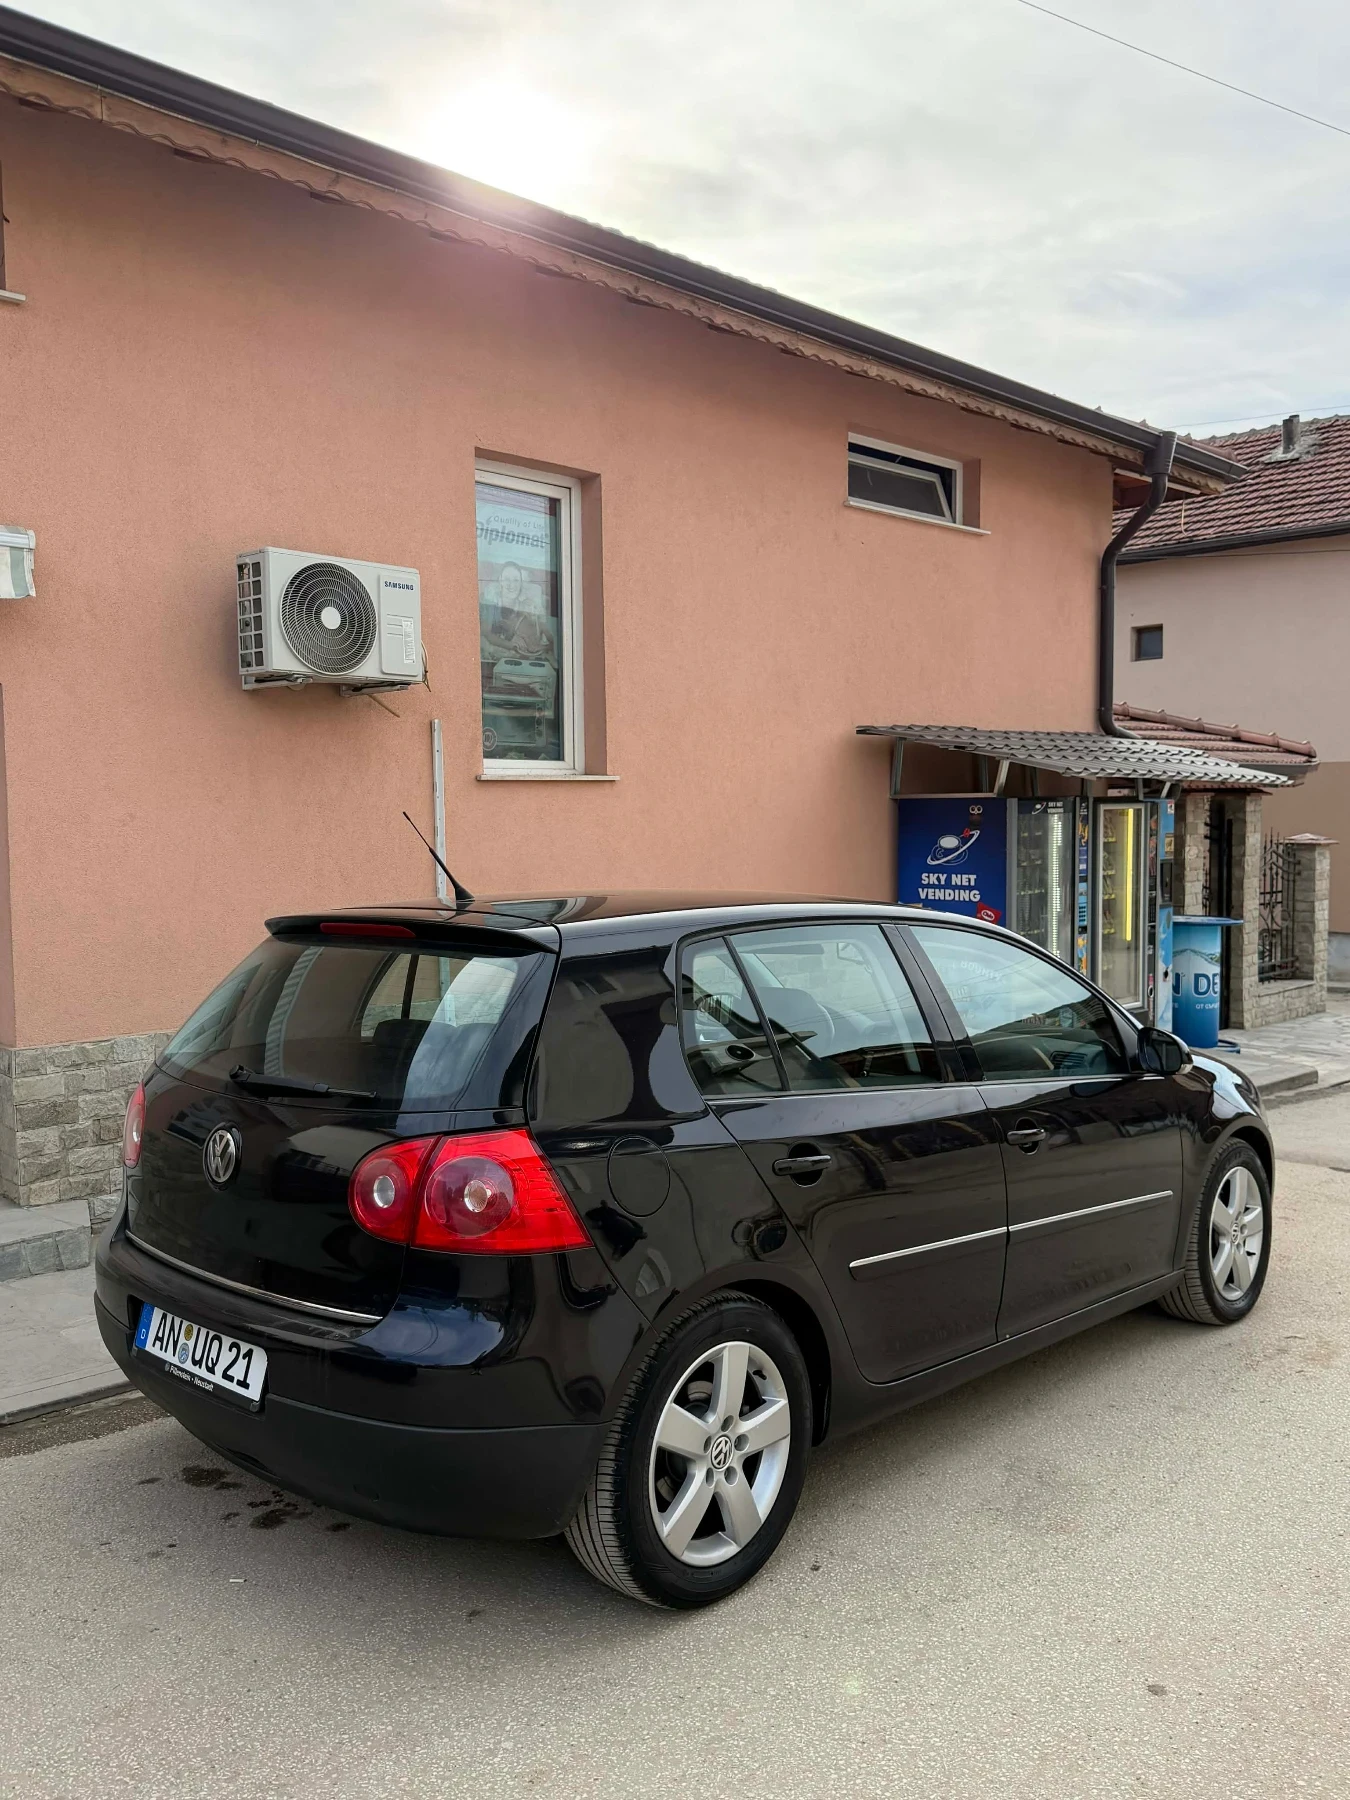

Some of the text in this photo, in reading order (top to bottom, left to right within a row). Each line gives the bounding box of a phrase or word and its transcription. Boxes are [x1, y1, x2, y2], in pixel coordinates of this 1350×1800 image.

[384, 580, 414, 591] SAMSUNG
[921, 873, 977, 886] SKY NET
[918, 888, 981, 902] VENDING
[152, 1312, 183, 1358] AN
[191, 1327, 223, 1376] UQ
[222, 1341, 254, 1390] 21
